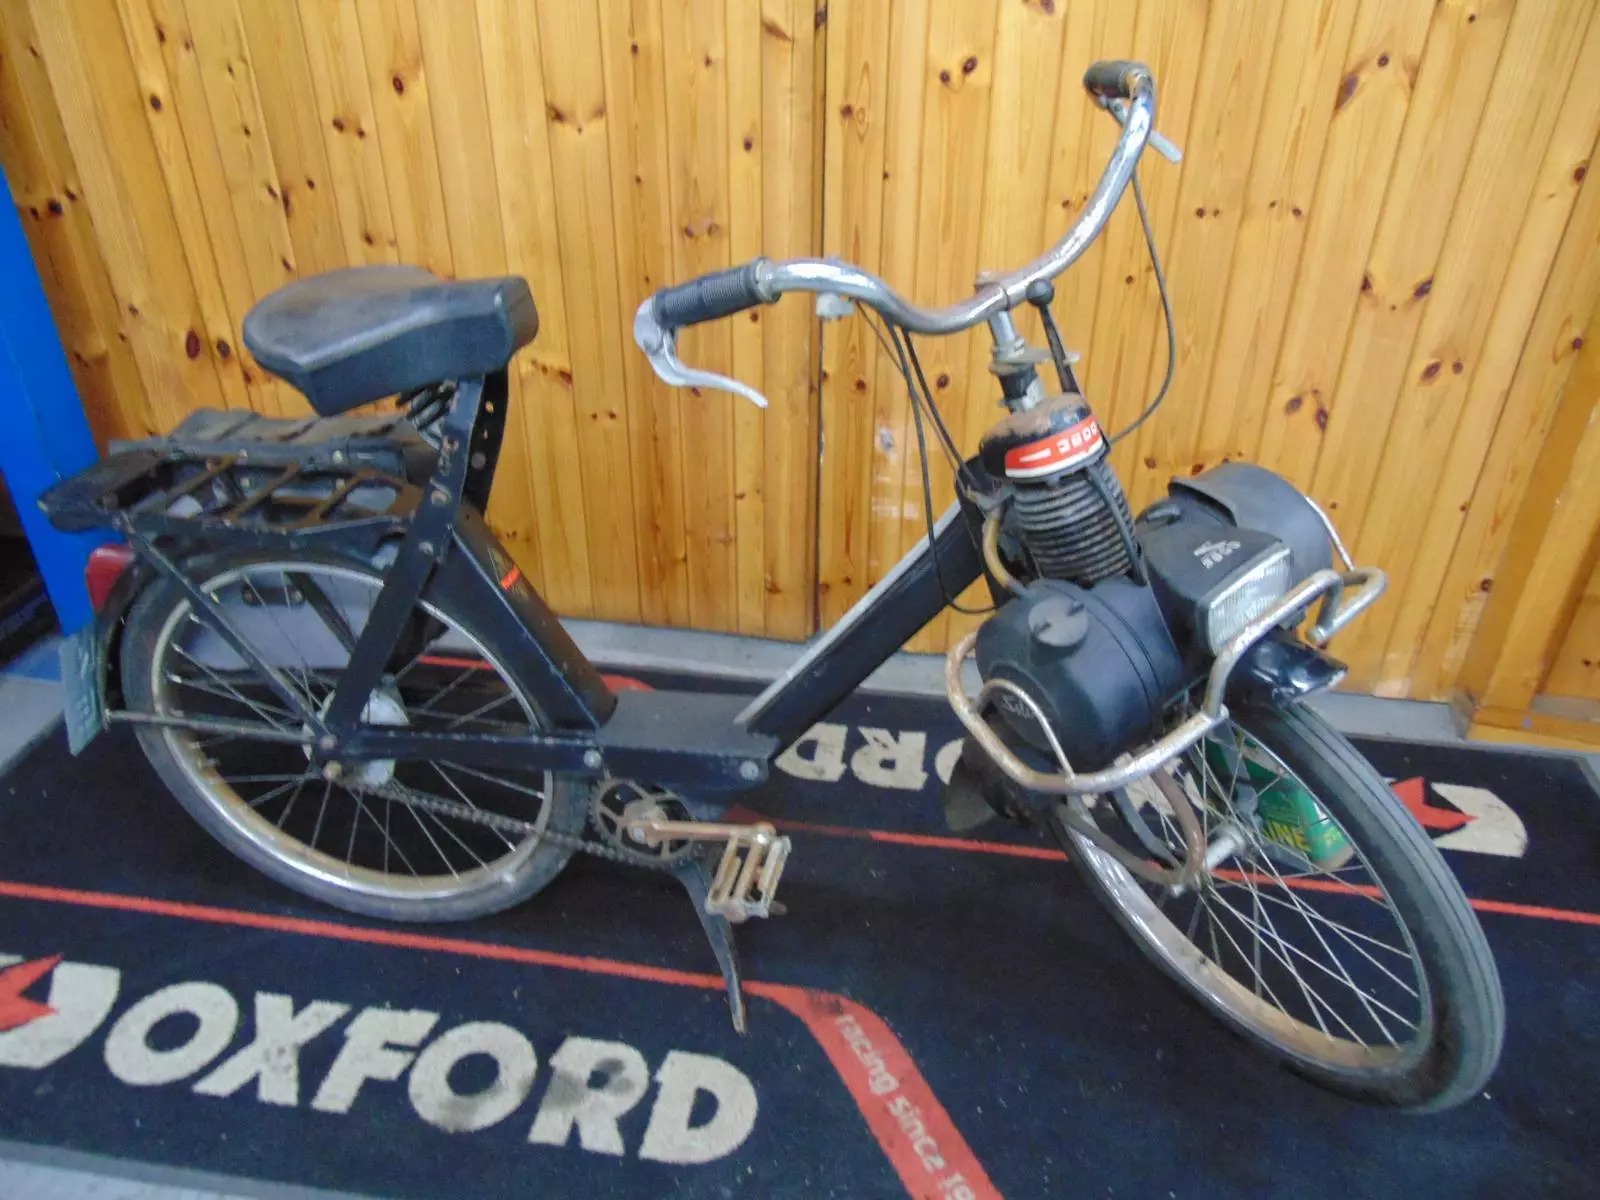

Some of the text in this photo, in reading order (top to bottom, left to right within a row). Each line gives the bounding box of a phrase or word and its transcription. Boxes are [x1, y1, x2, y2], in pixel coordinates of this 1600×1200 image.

[103, 980, 759, 1165] OXFORD
[836, 1014, 900, 1096] racing
[886, 1095, 946, 1173] since
